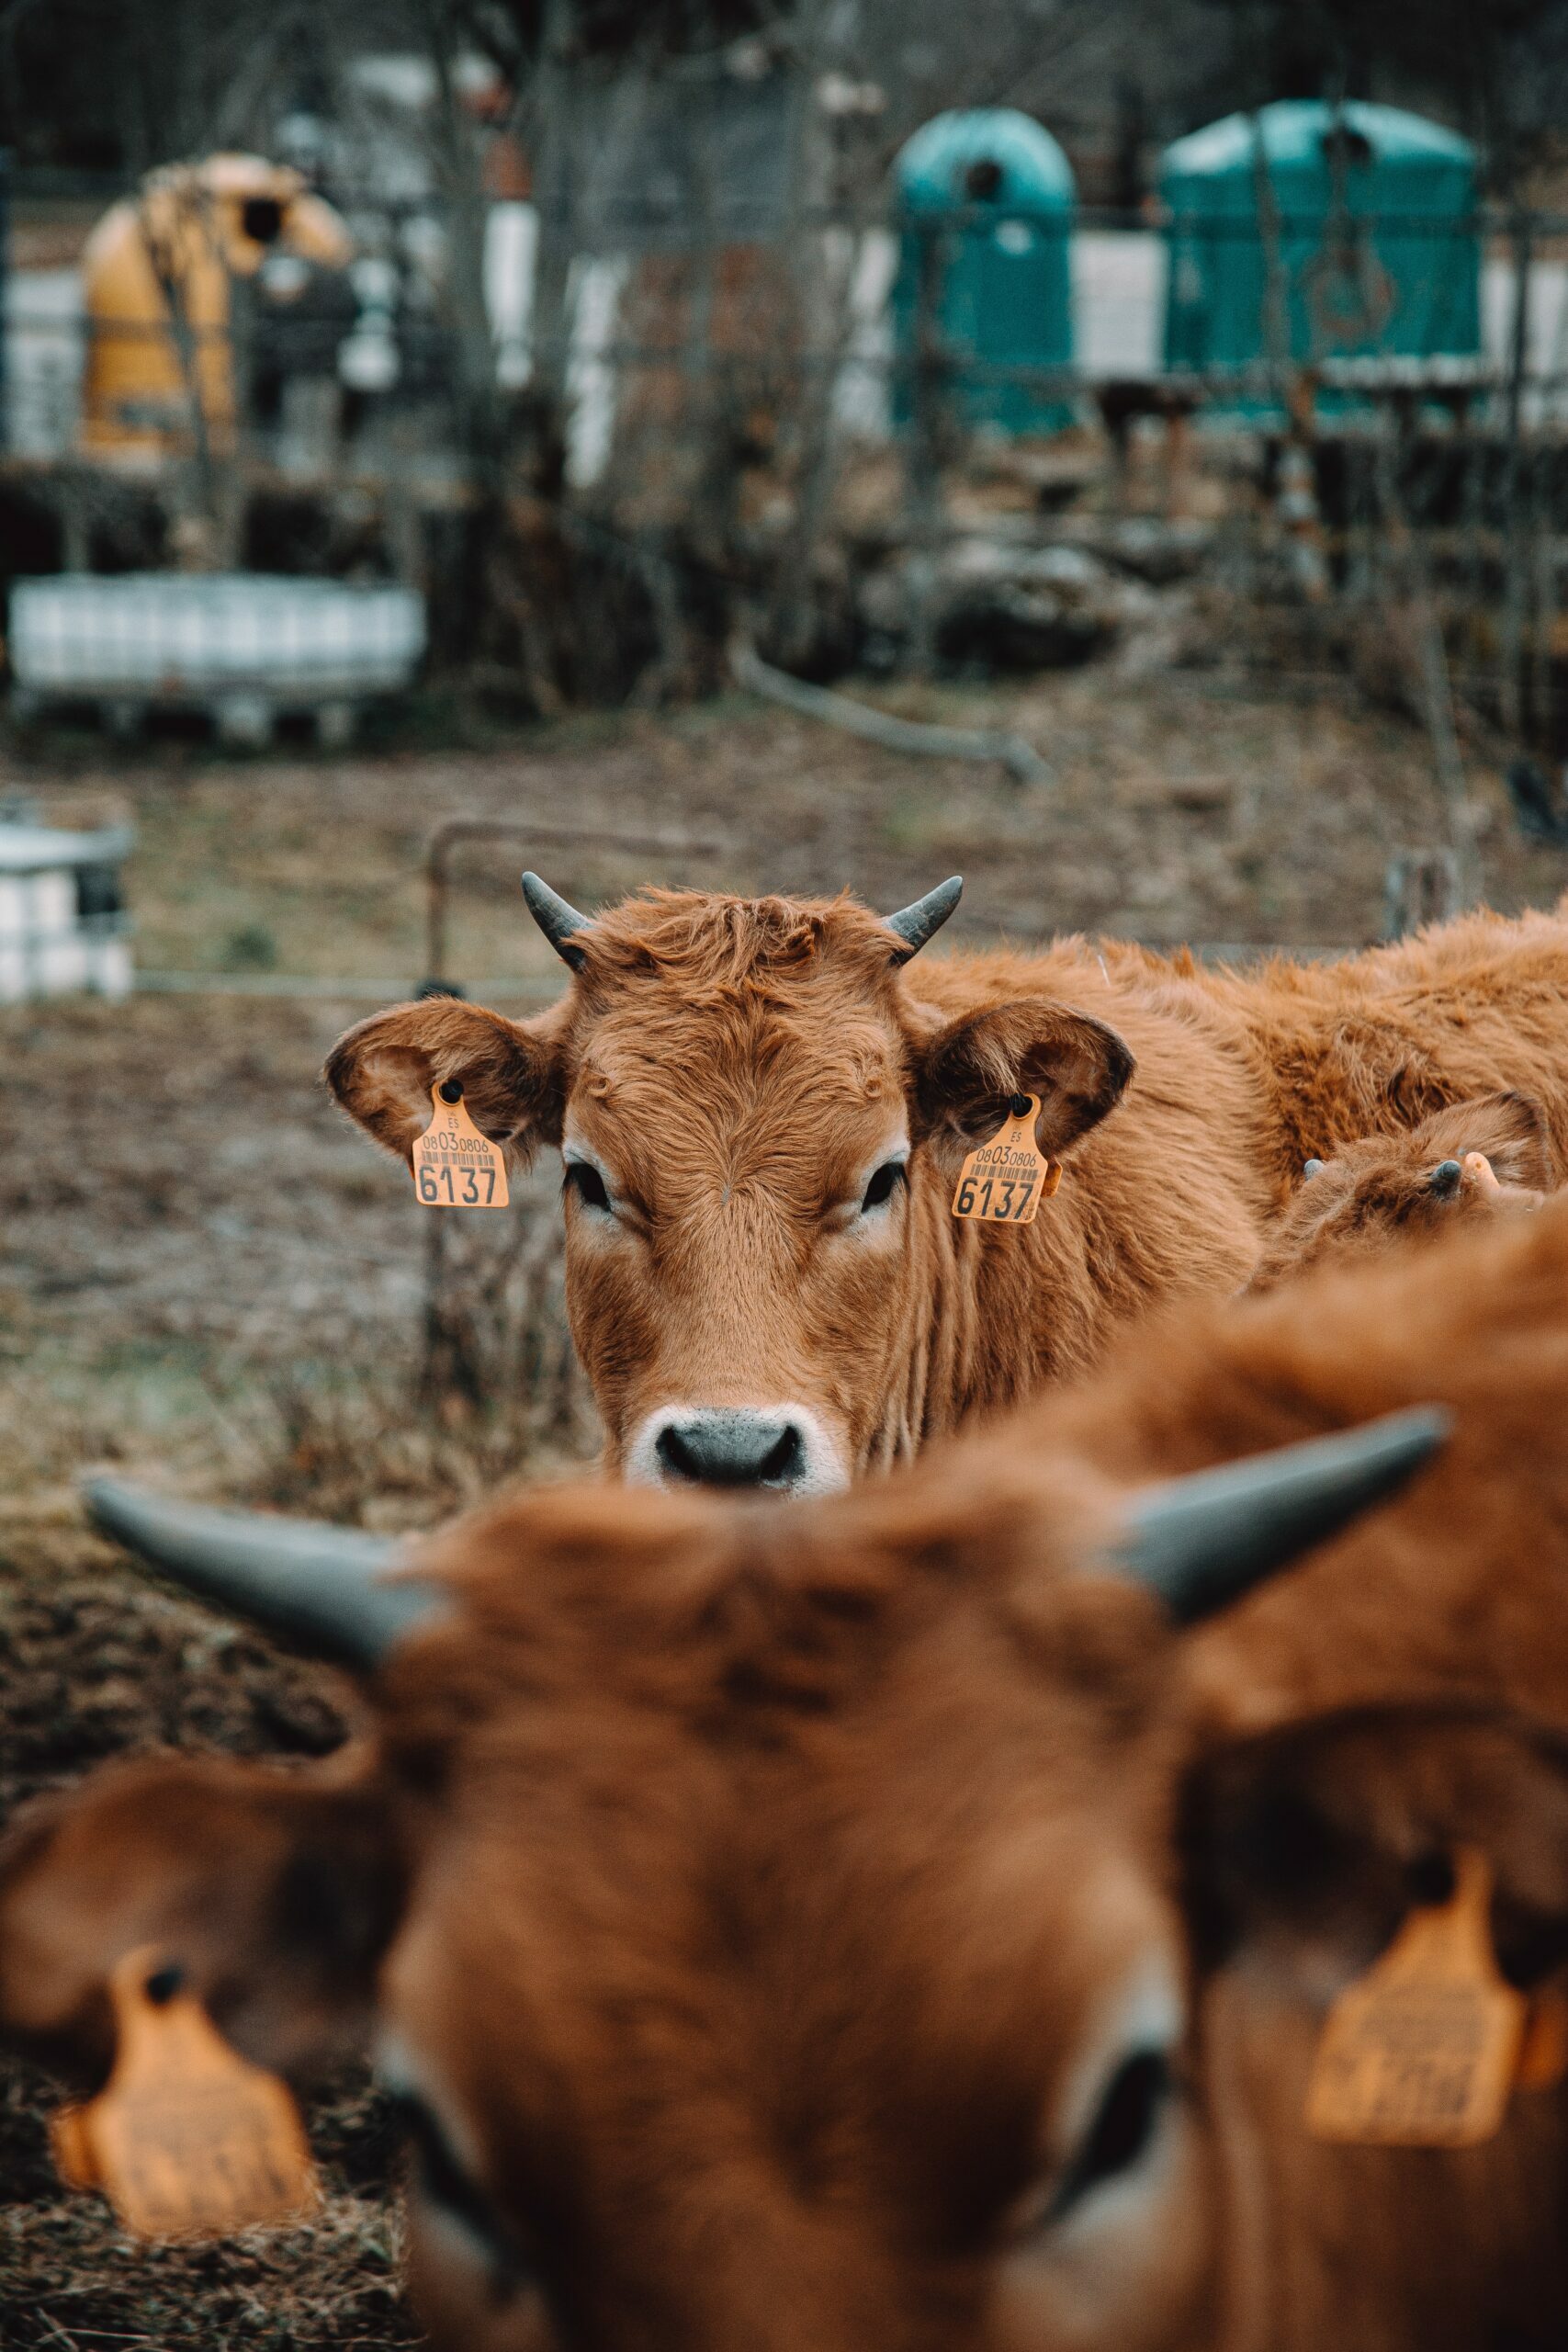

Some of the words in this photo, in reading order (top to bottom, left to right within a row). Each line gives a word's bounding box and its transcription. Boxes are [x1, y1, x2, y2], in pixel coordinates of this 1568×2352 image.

[448, 1117, 459, 1128] ES
[1010, 1131, 1021, 1142] ES
[419, 1165, 496, 1204] 6137
[957, 1177, 1034, 1220] 6137
